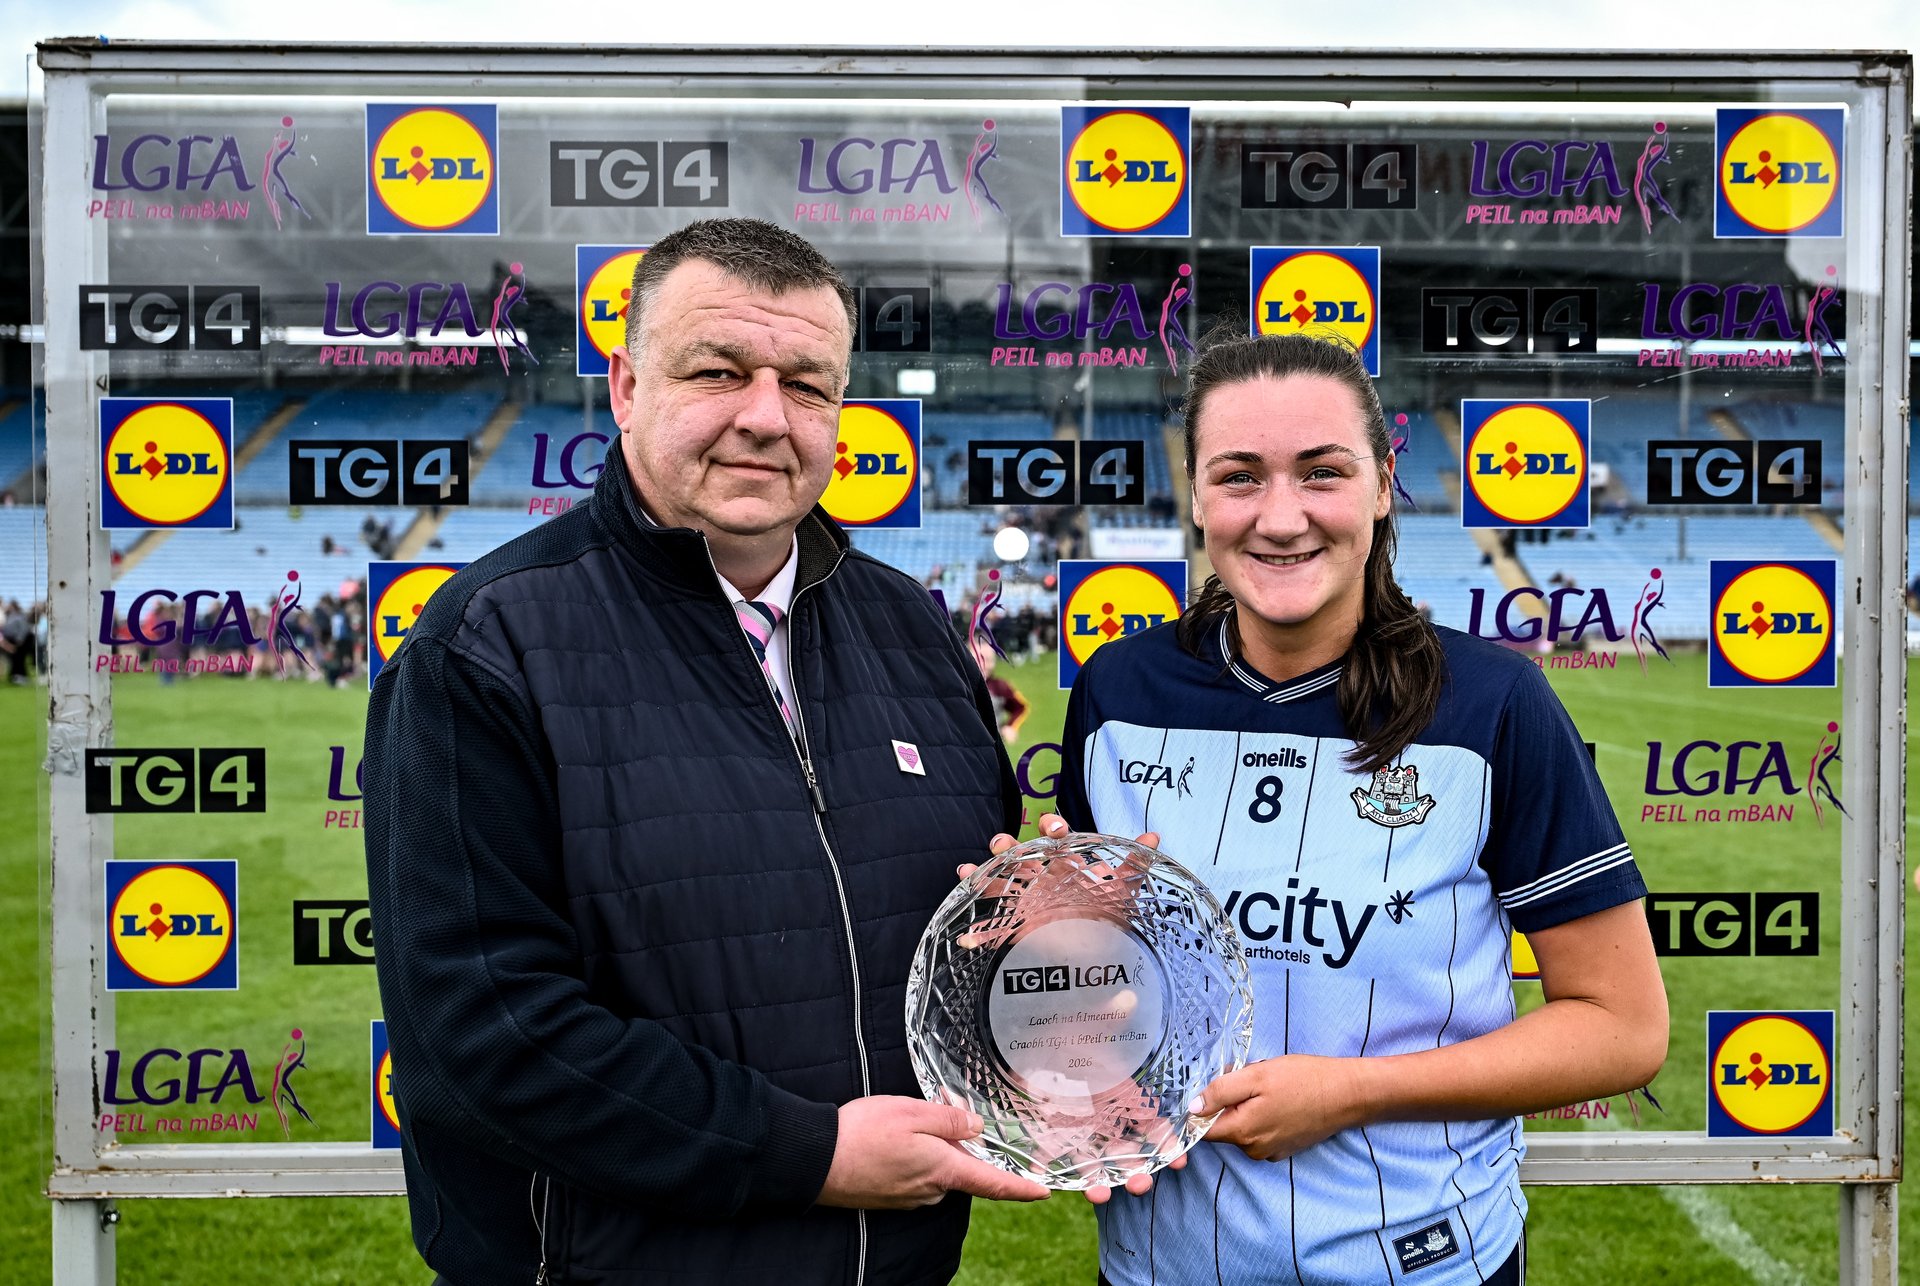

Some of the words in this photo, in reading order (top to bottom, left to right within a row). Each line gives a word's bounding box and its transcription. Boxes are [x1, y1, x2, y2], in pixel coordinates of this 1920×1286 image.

[92, 134, 256, 192] LGFA
[559, 148, 719, 201] TG4
[796, 137, 958, 196] LGFA
[1249, 151, 1407, 204] TG4
[1469, 140, 1629, 198] LGFA
[89, 200, 139, 220] PEIL
[146, 203, 174, 220] na
[179, 200, 250, 221] mBAN
[794, 203, 844, 222] PEIL
[849, 207, 876, 222] na
[882, 203, 951, 222] mBAN
[1466, 205, 1514, 224] PEIL
[1520, 209, 1548, 224] na
[1553, 205, 1622, 224] mBAN
[88, 292, 251, 344] TG4
[324, 281, 485, 339] LGFA
[994, 282, 1155, 341] LGFA
[1431, 295, 1587, 347] TG4
[1641, 283, 1800, 341] LGFA
[319, 347, 369, 367] PEIL
[375, 350, 403, 367] na
[408, 347, 478, 367] mBAN
[991, 347, 1040, 367] PEIL
[1045, 352, 1073, 367] na
[1078, 347, 1147, 368] mBAN
[1638, 349, 1686, 368] PEIL
[1692, 353, 1719, 368] na
[1724, 349, 1792, 368] mBAN
[298, 446, 458, 499] TG4
[532, 432, 609, 489] LG
[977, 447, 1134, 499] TG4
[1656, 447, 1812, 498] TG4
[100, 589, 261, 647] LGFA
[1468, 587, 1625, 643] LGFA
[96, 655, 144, 673] PEIL
[152, 659, 180, 673] na
[184, 654, 254, 673] mBAN
[1551, 651, 1617, 669] mBAN
[94, 755, 255, 807] TG4
[1119, 759, 1176, 789] LGFA
[1644, 740, 1802, 797] LGFA
[325, 810, 364, 828] PEI
[1248, 775, 1283, 824] 8
[1641, 804, 1687, 823] PEIL
[1695, 808, 1721, 822] na
[1727, 804, 1794, 822] mBAN
[303, 907, 375, 957] TG
[1655, 900, 1809, 949] TG4
[1006, 968, 1066, 992] TG4
[1075, 964, 1131, 988] LGFA
[1244, 946, 1311, 965] arthotels
[1009, 1037, 1044, 1050] Craobh
[1119, 1031, 1147, 1042] mBan
[1029, 1013, 1058, 1026] Laoch
[103, 1048, 266, 1105] LGFA
[1068, 1057, 1092, 1068] 2026
[100, 1114, 147, 1132] PEIL
[155, 1118, 182, 1132] na
[189, 1113, 258, 1132] mBAN
